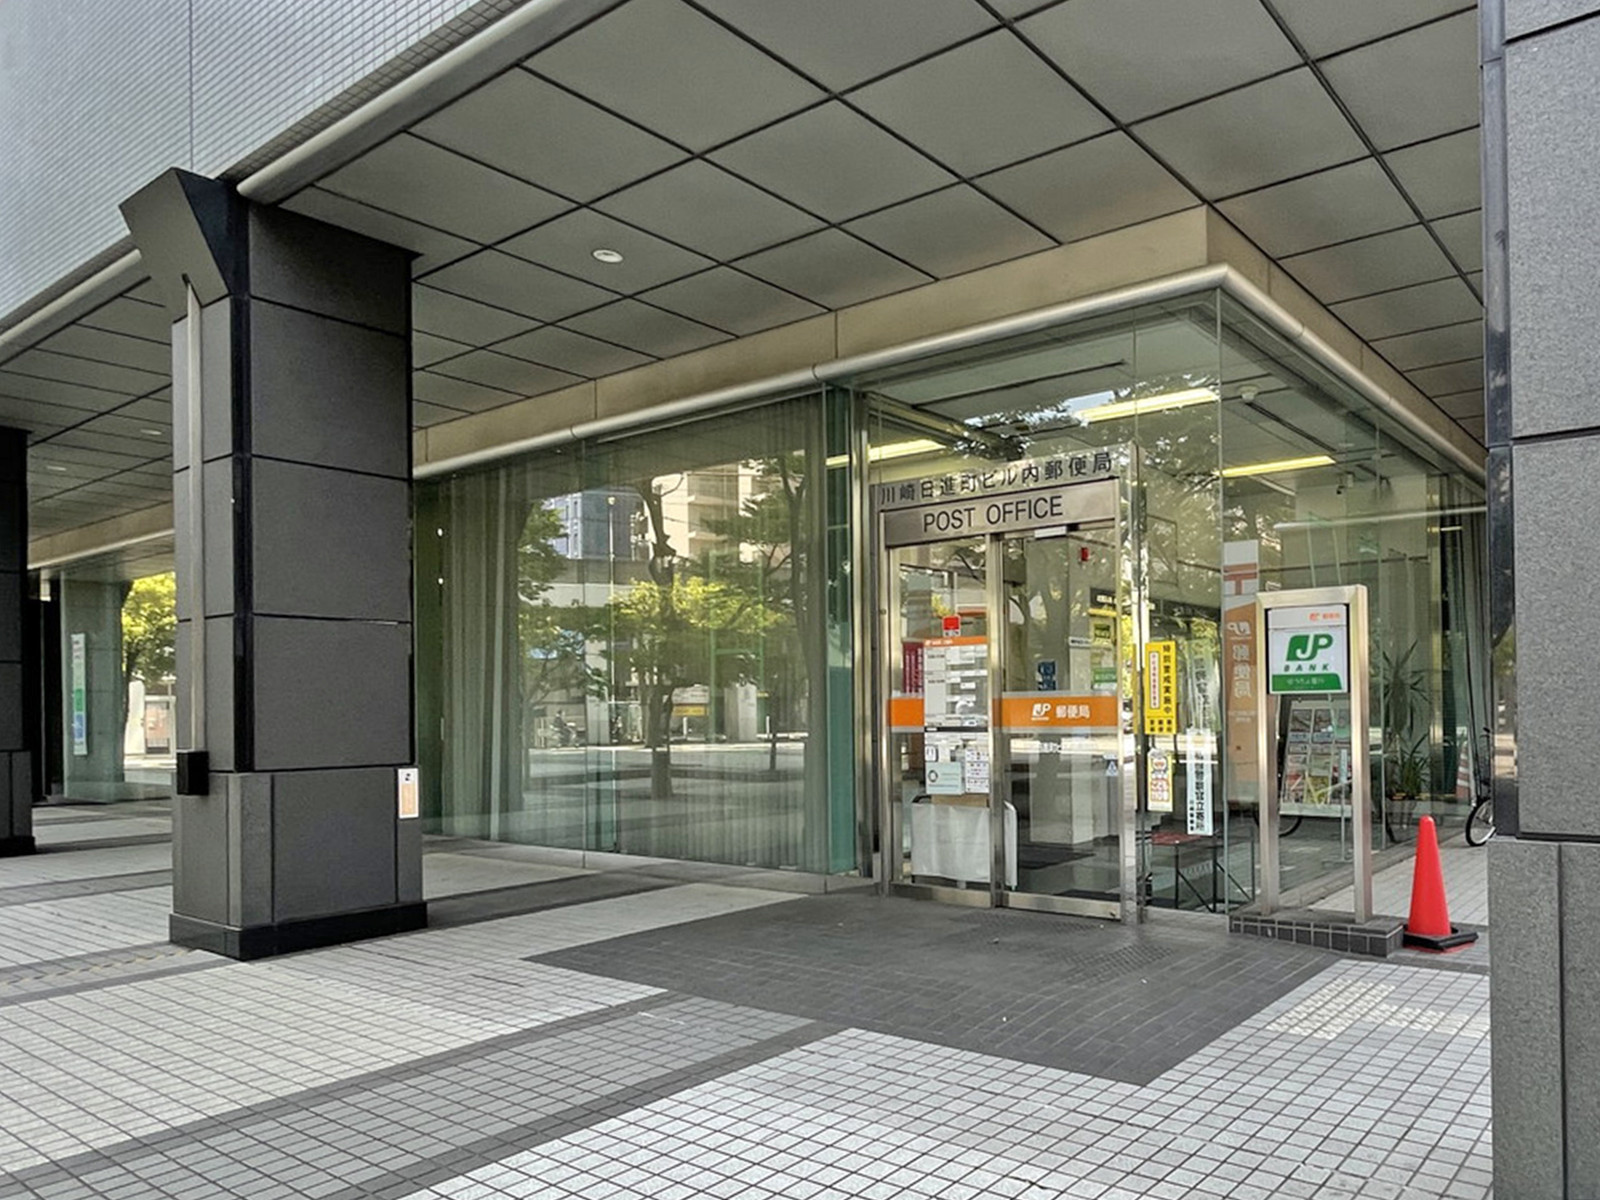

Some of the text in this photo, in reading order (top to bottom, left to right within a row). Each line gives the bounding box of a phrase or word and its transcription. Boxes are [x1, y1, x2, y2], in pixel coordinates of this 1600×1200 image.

[881, 452, 1112, 505] 川崎日進町ビル内郵便局
[923, 495, 1063, 533] POST OFFICE
[1286, 633, 1333, 662] JP
[1283, 663, 1330, 672] BANK
